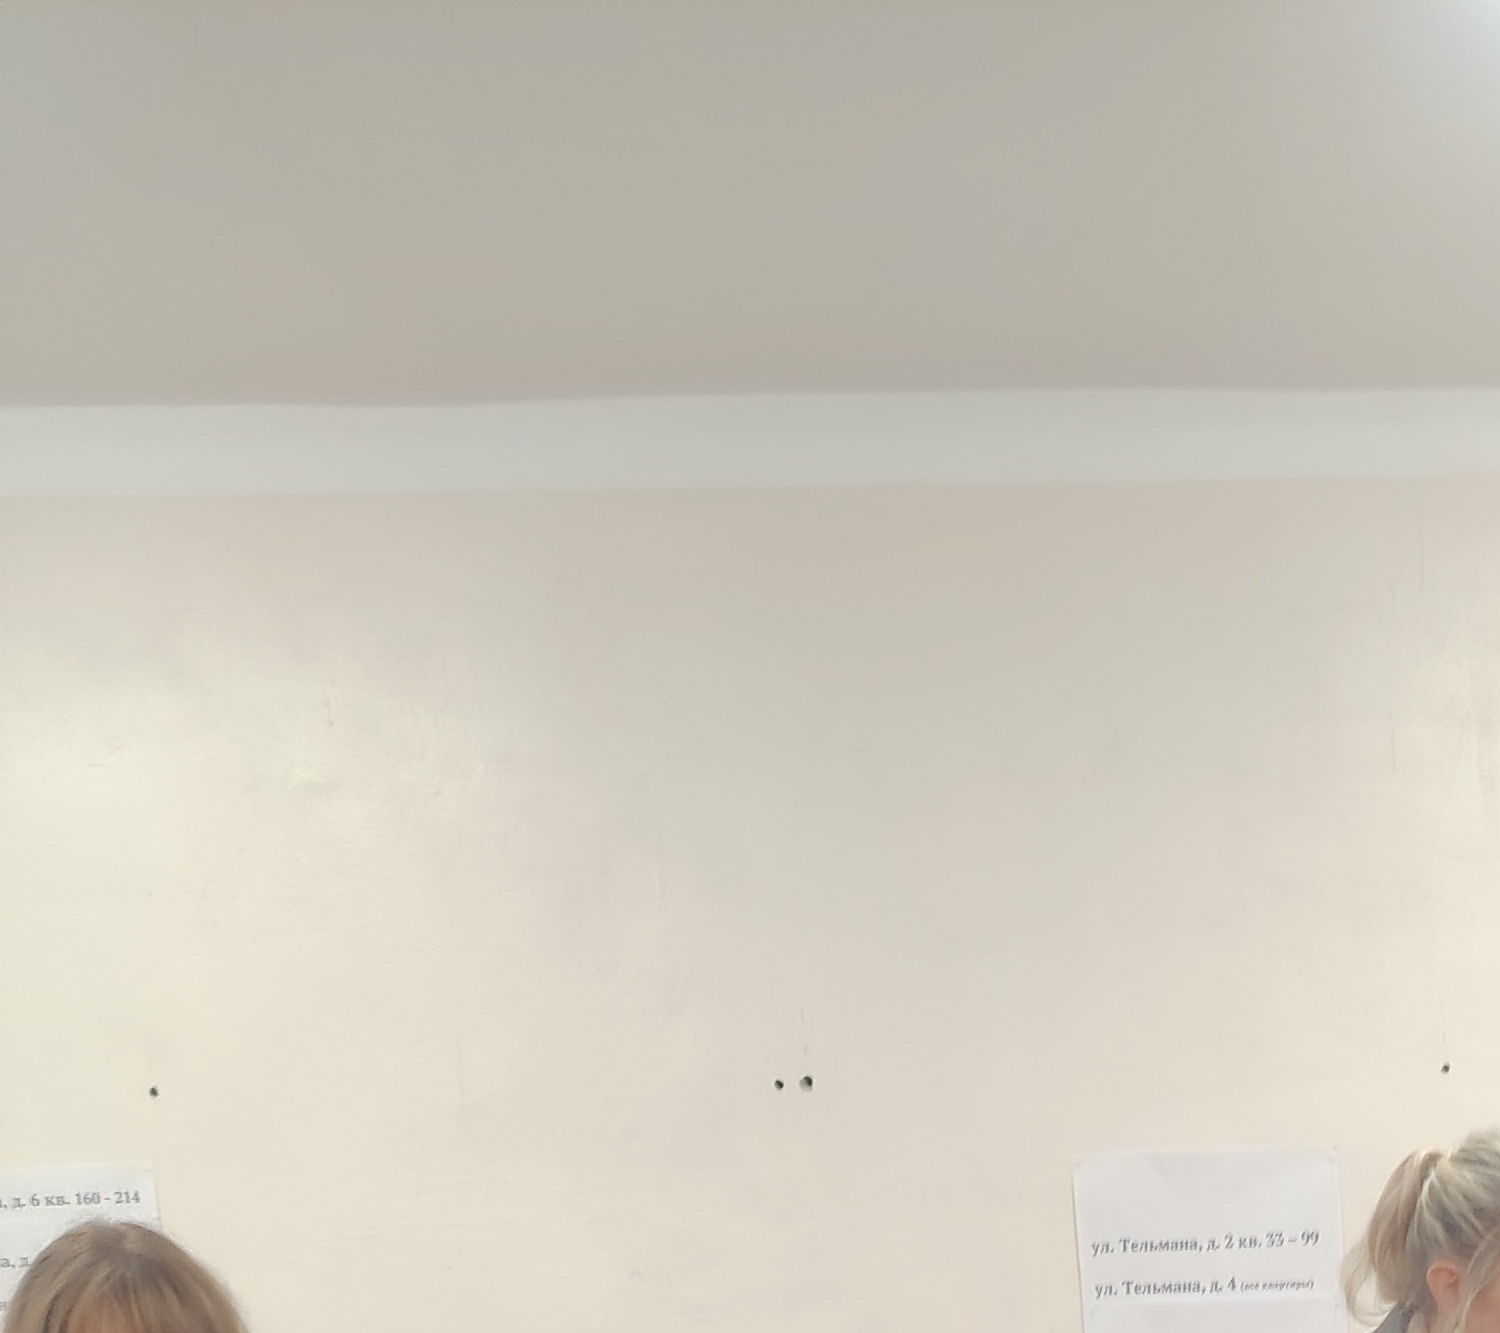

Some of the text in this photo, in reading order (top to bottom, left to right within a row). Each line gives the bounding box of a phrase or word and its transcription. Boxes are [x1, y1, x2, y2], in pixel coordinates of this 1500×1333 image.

[30, 1193, 41, 1208] 6
[114, 1191, 141, 1205] 214
[1091, 1241, 1115, 1257] ул.
[1119, 1237, 1203, 1253] Тельмана,
[1224, 1232, 1235, 1249] 2
[1300, 1229, 1319, 1246] 99
[1094, 1283, 1118, 1300] ул.
[1122, 1280, 1206, 1295] Тельмана,
